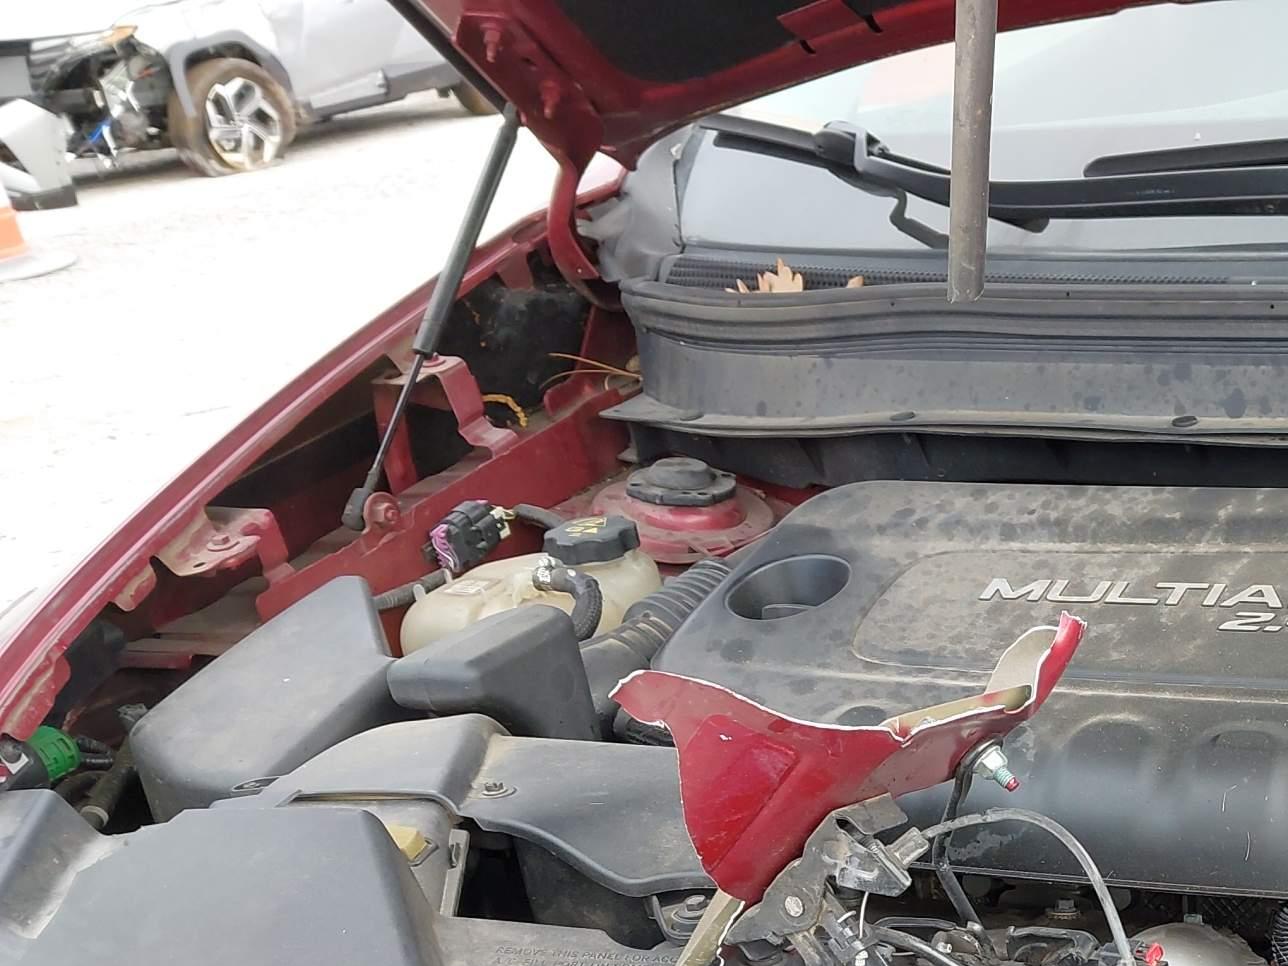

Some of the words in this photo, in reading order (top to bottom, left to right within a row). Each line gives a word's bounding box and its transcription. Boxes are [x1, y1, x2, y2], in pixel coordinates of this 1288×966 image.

[551, 949, 579, 958] THIS
[582, 951, 619, 960] PANEL
[623, 953, 650, 962] FOR
